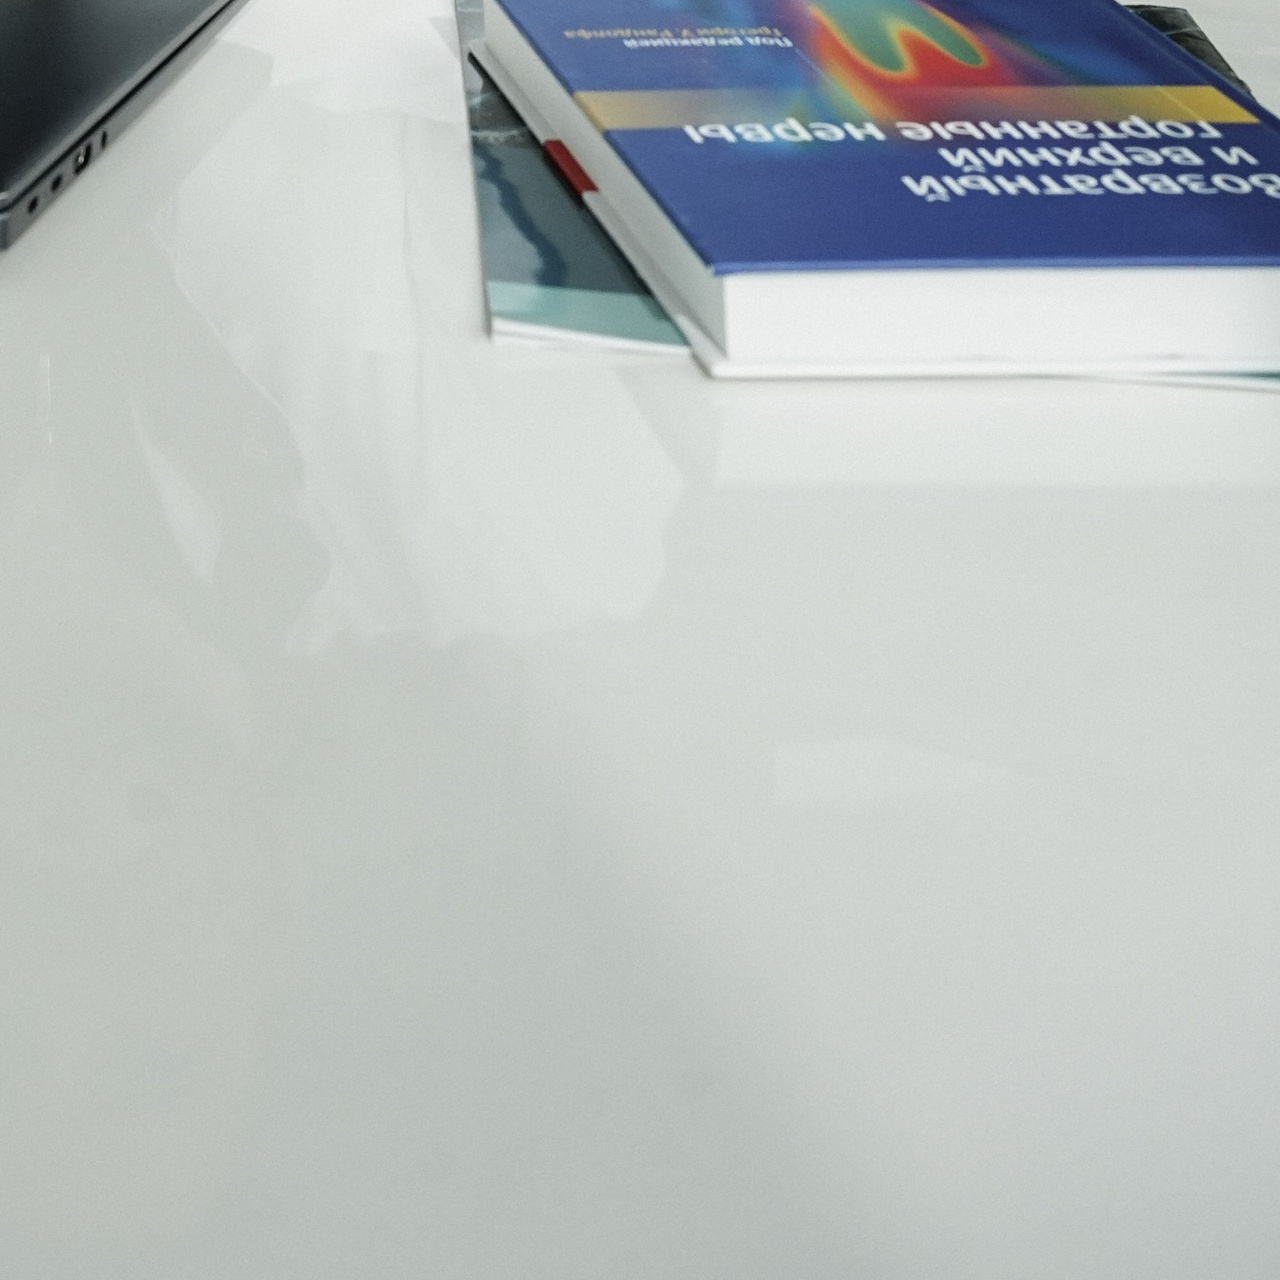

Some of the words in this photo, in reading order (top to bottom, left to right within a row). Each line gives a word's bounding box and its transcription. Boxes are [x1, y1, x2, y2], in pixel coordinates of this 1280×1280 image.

[682, 117, 887, 144] нервы
[894, 115, 1223, 141] гортанные
[937, 140, 1205, 173] верхний
[1211, 146, 1260, 166] и
[900, 169, 1280, 203] Возвратный
